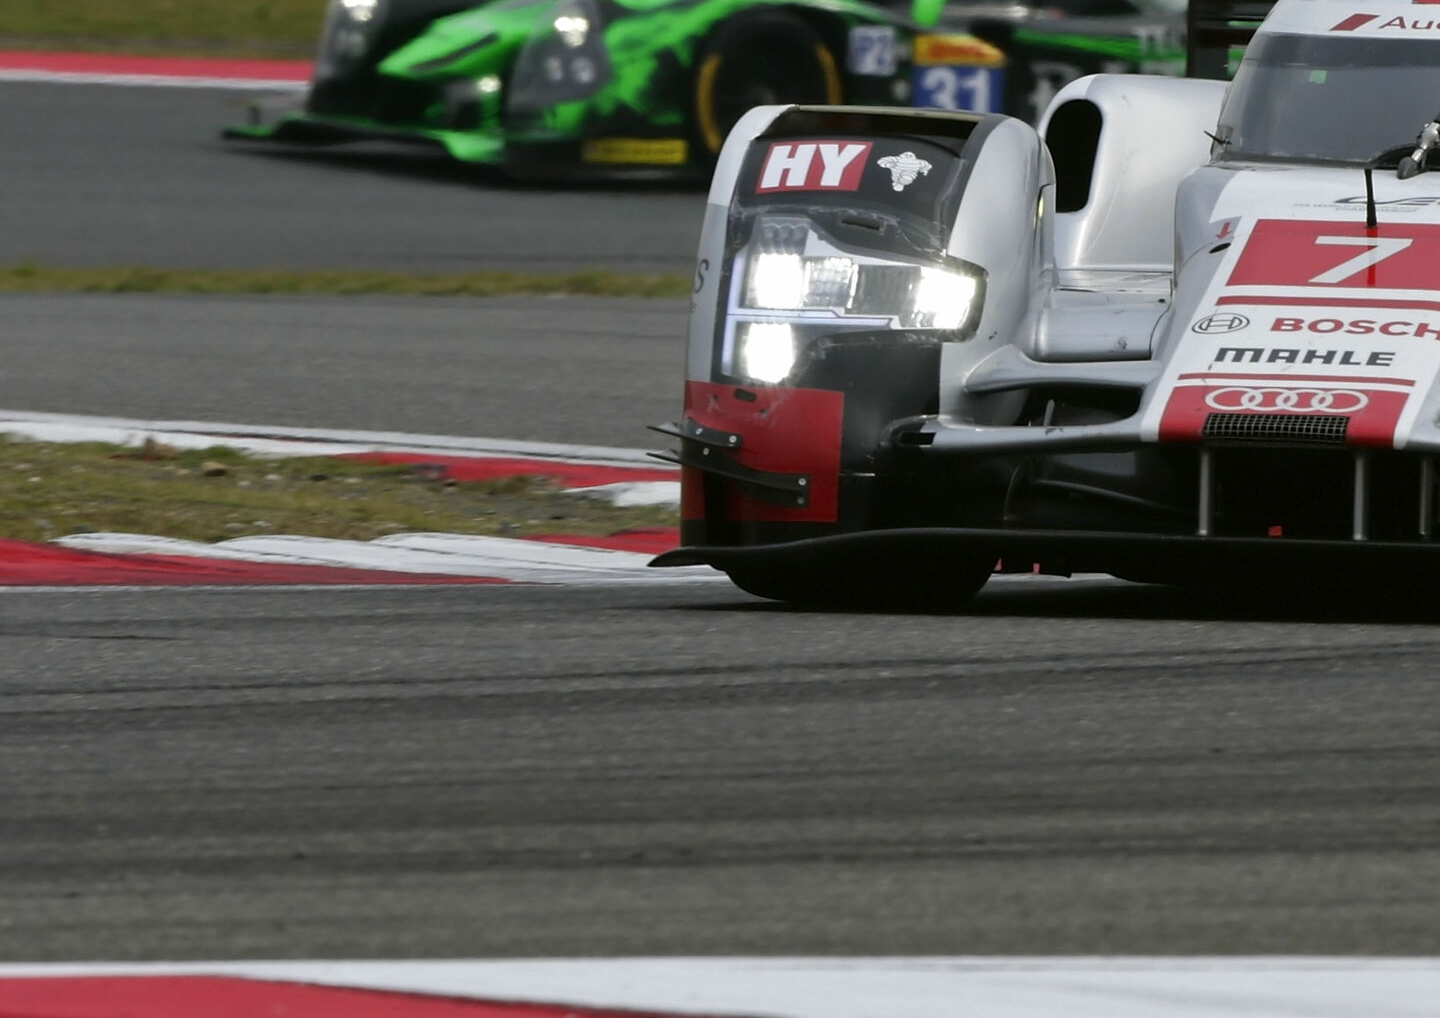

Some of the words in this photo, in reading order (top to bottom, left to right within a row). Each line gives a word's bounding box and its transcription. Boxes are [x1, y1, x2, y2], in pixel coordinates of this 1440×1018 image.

[922, 67, 990, 112] 31
[760, 143, 868, 189] HY
[1307, 235, 1414, 284] 7
[1213, 347, 1396, 367] MAHLE
